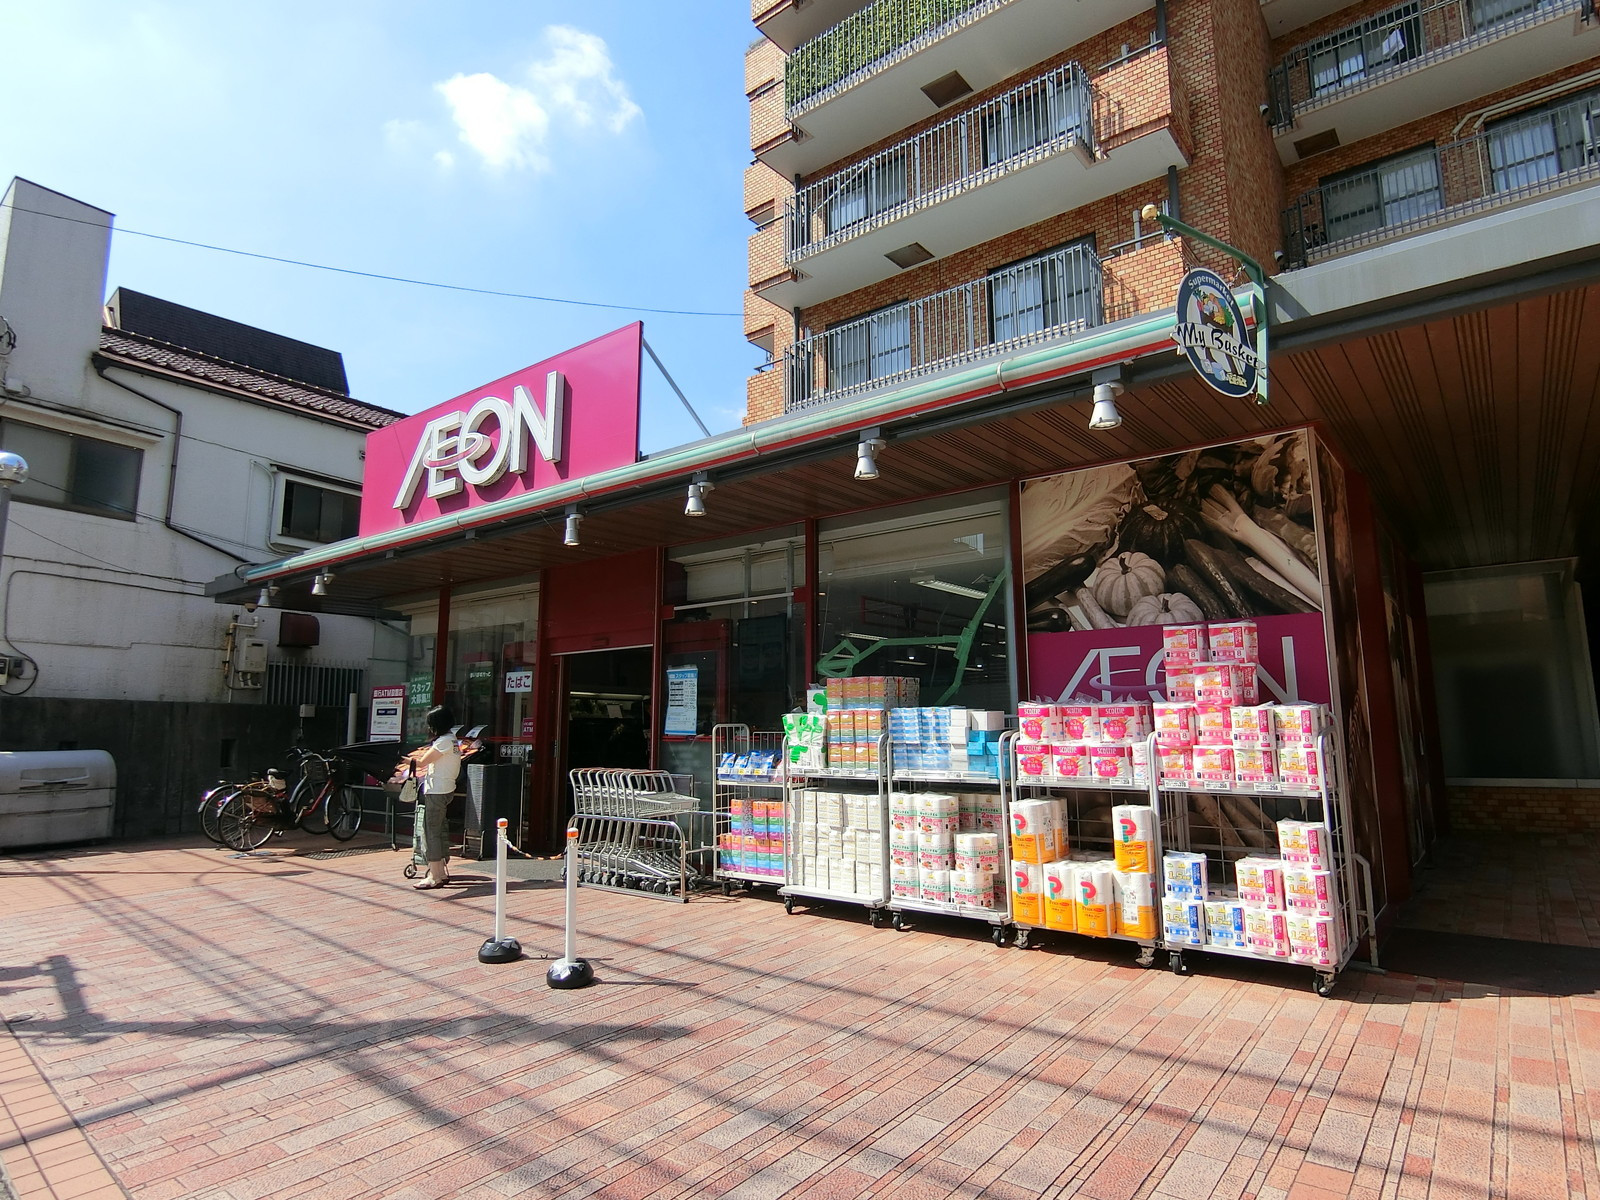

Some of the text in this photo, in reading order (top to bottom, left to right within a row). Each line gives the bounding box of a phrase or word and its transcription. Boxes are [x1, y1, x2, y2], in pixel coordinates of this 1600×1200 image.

[1187, 276, 1235, 305] Supermarket
[1177, 323, 1259, 368] My Basket
[411, 682, 431, 693] スタッフ
[507, 675, 531, 689] たばこ
